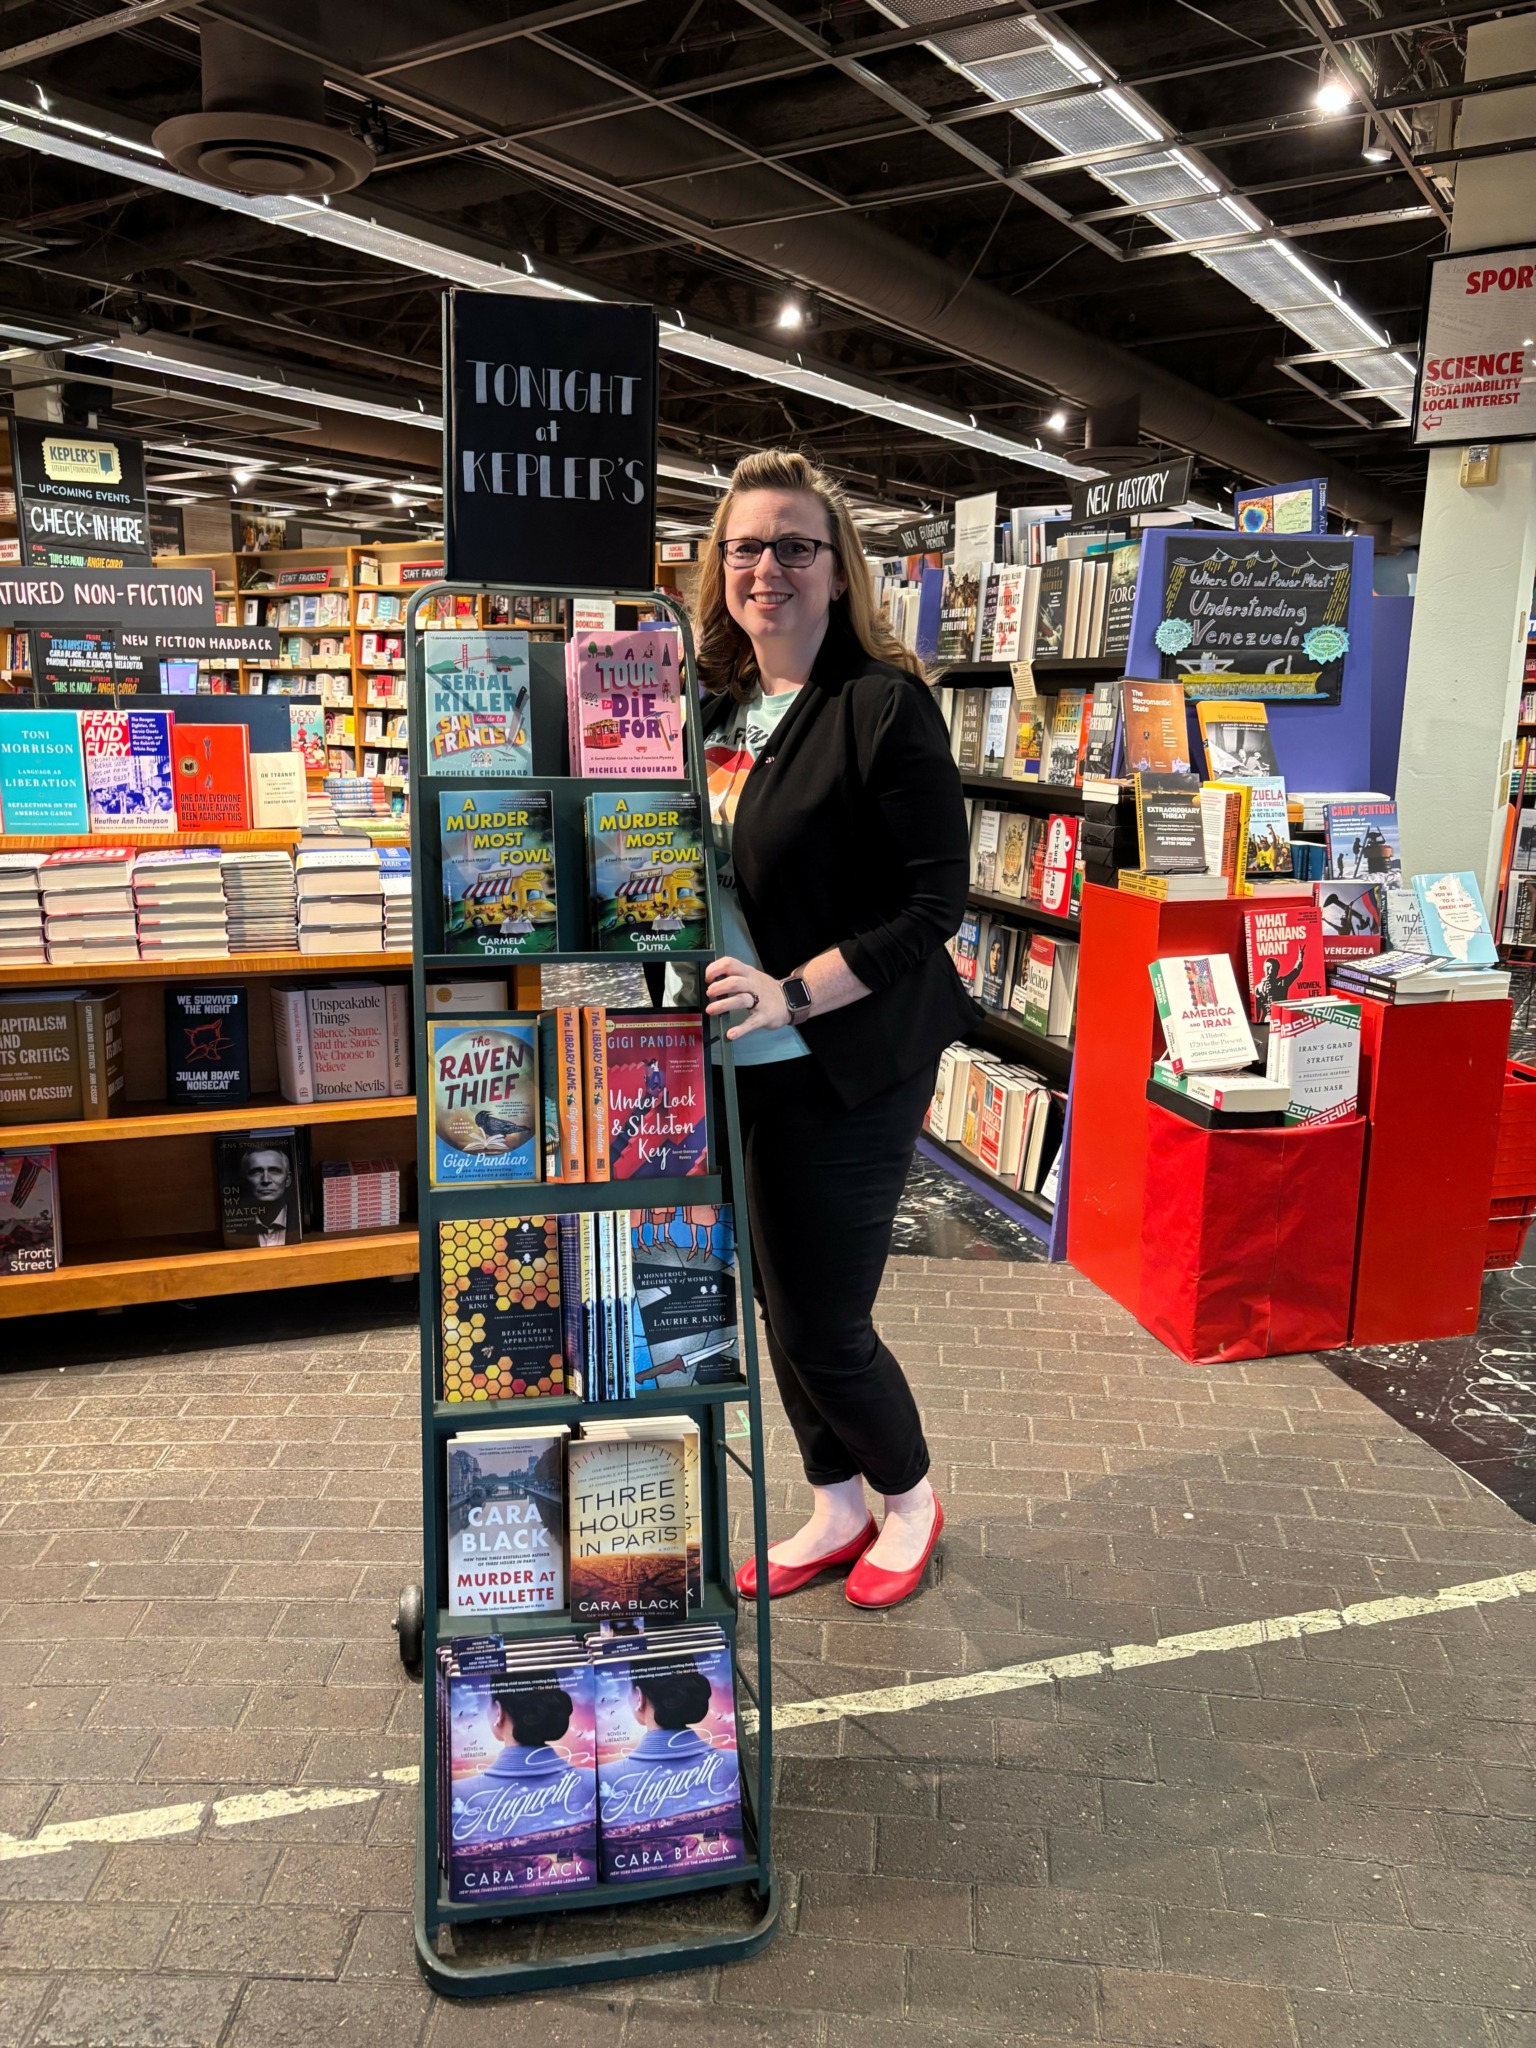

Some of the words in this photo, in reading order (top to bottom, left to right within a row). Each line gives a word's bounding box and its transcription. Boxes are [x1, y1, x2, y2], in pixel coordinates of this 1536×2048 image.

[1426, 351, 1525, 381] SCIENCE
[466, 360, 642, 415] TONIGHT
[1424, 378, 1521, 397] SUSTAINABILITY
[1422, 397, 1459, 412] LOCAL
[1462, 392, 1520, 409] INTEREST
[536, 420, 560, 442] at
[49, 446, 97, 463] KEPLER'S
[463, 450, 644, 505] KEPLER'S
[38, 483, 93, 499] UPCOMING
[96, 491, 131, 504] EVENTS
[1086, 482, 1114, 518] NEW
[1116, 470, 1170, 510] HISTORY
[30, 506, 109, 541] CHECK-IN
[111, 516, 145, 545] HERE
[901, 530, 916, 549] NEW
[919, 520, 950, 540] BIOGRAPHY
[299, 572, 327, 583] FAVORITES
[402, 569, 419, 579] STAFF
[421, 567, 444, 578] FAVORIT
[1189, 569, 1228, 586] Where
[1231, 571, 1252, 586] Oil
[1268, 571, 1300, 587] Power
[74, 583, 203, 606] NON-FICTION
[1110, 585, 1136, 605] ZORG
[1189, 590, 1307, 626] Understanding
[1192, 619, 1300, 646] Venezuela
[122, 634, 148, 646] NEW
[155, 635, 206, 649] FICTION
[209, 637, 273, 651] HARDBACK
[624, 648, 635, 661] A
[596, 661, 660, 693] TOUR
[1131, 689, 1143, 697] The
[434, 692, 518, 712] KILLER
[1132, 697, 1172, 706] Necromantic
[1132, 705, 1149, 713] State
[84, 712, 128, 726] FEAR
[22, 730, 50, 740] TONI
[85, 727, 123, 741] AND
[620, 719, 662, 739] FOR
[0, 743, 74, 754] MORRISON
[86, 743, 130, 756] FURY
[5, 779, 77, 787] LIBERATION
[180, 794, 194, 802] ONE
[195, 794, 207, 803] DAY,
[209, 794, 241, 803] EVERYONE
[463, 798, 475, 812] A
[181, 803, 196, 812] WILL
[198, 803, 213, 812] HAVE
[215, 803, 240, 812] ALWAYS
[1146, 806, 1200, 814] EXTRAORDINARY
[1331, 805, 1356, 816] CAMP
[1358, 804, 1395, 815] CENTURY
[94, 817, 119, 825] Heather
[136, 817, 168, 826] Thompson
[181, 812, 198, 820] BEEN
[199, 812, 226, 821] AGAINST
[227, 812, 241, 821] THIS
[446, 811, 529, 832] MURDER
[473, 832, 523, 849] MOST
[500, 848, 550, 866] FOWL
[1255, 913, 1287, 928] WHAT
[477, 935, 527, 946] CARMELA
[1256, 926, 1306, 942] IRANIANS
[484, 945, 520, 955] DUTRA
[1257, 941, 1289, 956] WANT
[1324, 947, 1374, 955] VENEZUELA
[177, 995, 191, 1005] WE
[194, 994, 238, 1005] SURVIVED
[311, 995, 380, 1012] Unspeakable
[184, 1005, 201, 1014] THE
[204, 1004, 231, 1014] NIGHT
[1181, 1007, 1236, 1019] AMERICA
[312, 1012, 350, 1027] Things
[1202, 1017, 1232, 1029] IRAN
[313, 1027, 347, 1038] Silence,
[348, 1026, 382, 1037] Shame,
[314, 1039, 332, 1050] and
[333, 1038, 348, 1049] the
[350, 1037, 380, 1048] Stories
[607, 1036, 634, 1049] GIGI
[640, 1034, 696, 1048] PANDIAN
[1298, 1044, 1325, 1053] IRAN'S
[1326, 1041, 1353, 1051] GRAND
[314, 1051, 329, 1061] We
[330, 1050, 364, 1061] Choose
[365, 1049, 375, 1059] to
[1306, 1055, 1344, 1065] STRATEGY
[315, 1062, 346, 1073] Believe
[439, 1044, 525, 1082] RAVEN
[176, 1071, 208, 1082] JULIAN
[210, 1070, 240, 1081] BRAVE
[187, 1080, 229, 1091] NOISECAT
[316, 1082, 353, 1096] Brooke
[354, 1080, 386, 1093] Nevils
[444, 1073, 520, 1110] THIEF
[1304, 1086, 1321, 1094] VALI
[1323, 1084, 1343, 1092] NASR
[609, 1087, 657, 1112] Under
[663, 1085, 697, 1108] Lock
[611, 1119, 625, 1136] &
[638, 1138, 671, 1170] Key
[443, 1153, 472, 1175] Gigi
[474, 1152, 529, 1167] Pandian
[223, 1187, 240, 1195] ON
[223, 1197, 240, 1206] MY
[224, 1206, 266, 1217] WATCH
[18, 1248, 53, 1259] Front
[10, 1259, 53, 1271] Street
[460, 1294, 488, 1302] LAURIE
[653, 1316, 690, 1327] LAURIE
[691, 1316, 701, 1324] R.
[702, 1314, 726, 1323] KING
[501, 1328, 554, 1337] BEEKEEPER'S
[503, 1335, 552, 1344] APPRENTICE
[574, 1478, 675, 1514] THREE
[467, 1503, 543, 1527] CARA
[579, 1503, 676, 1537] HOURS
[461, 1528, 549, 1553] BLACK
[579, 1540, 601, 1558] IN
[612, 1526, 678, 1552] PARIS
[457, 1570, 534, 1588] MURDER
[539, 1571, 556, 1582] AT
[458, 1595, 475, 1606] LA
[478, 1587, 554, 1605] VILLETTE
[579, 1600, 622, 1612] CARA
[628, 1599, 679, 1610] BLACK
[600, 1752, 737, 1824] Huguette
[452, 1773, 596, 1841] Huguette
[614, 1851, 663, 1868] CARA
[675, 1840, 730, 1859] BLACK
[464, 1872, 514, 1888] CARA
[526, 1861, 584, 1881] BLACK
